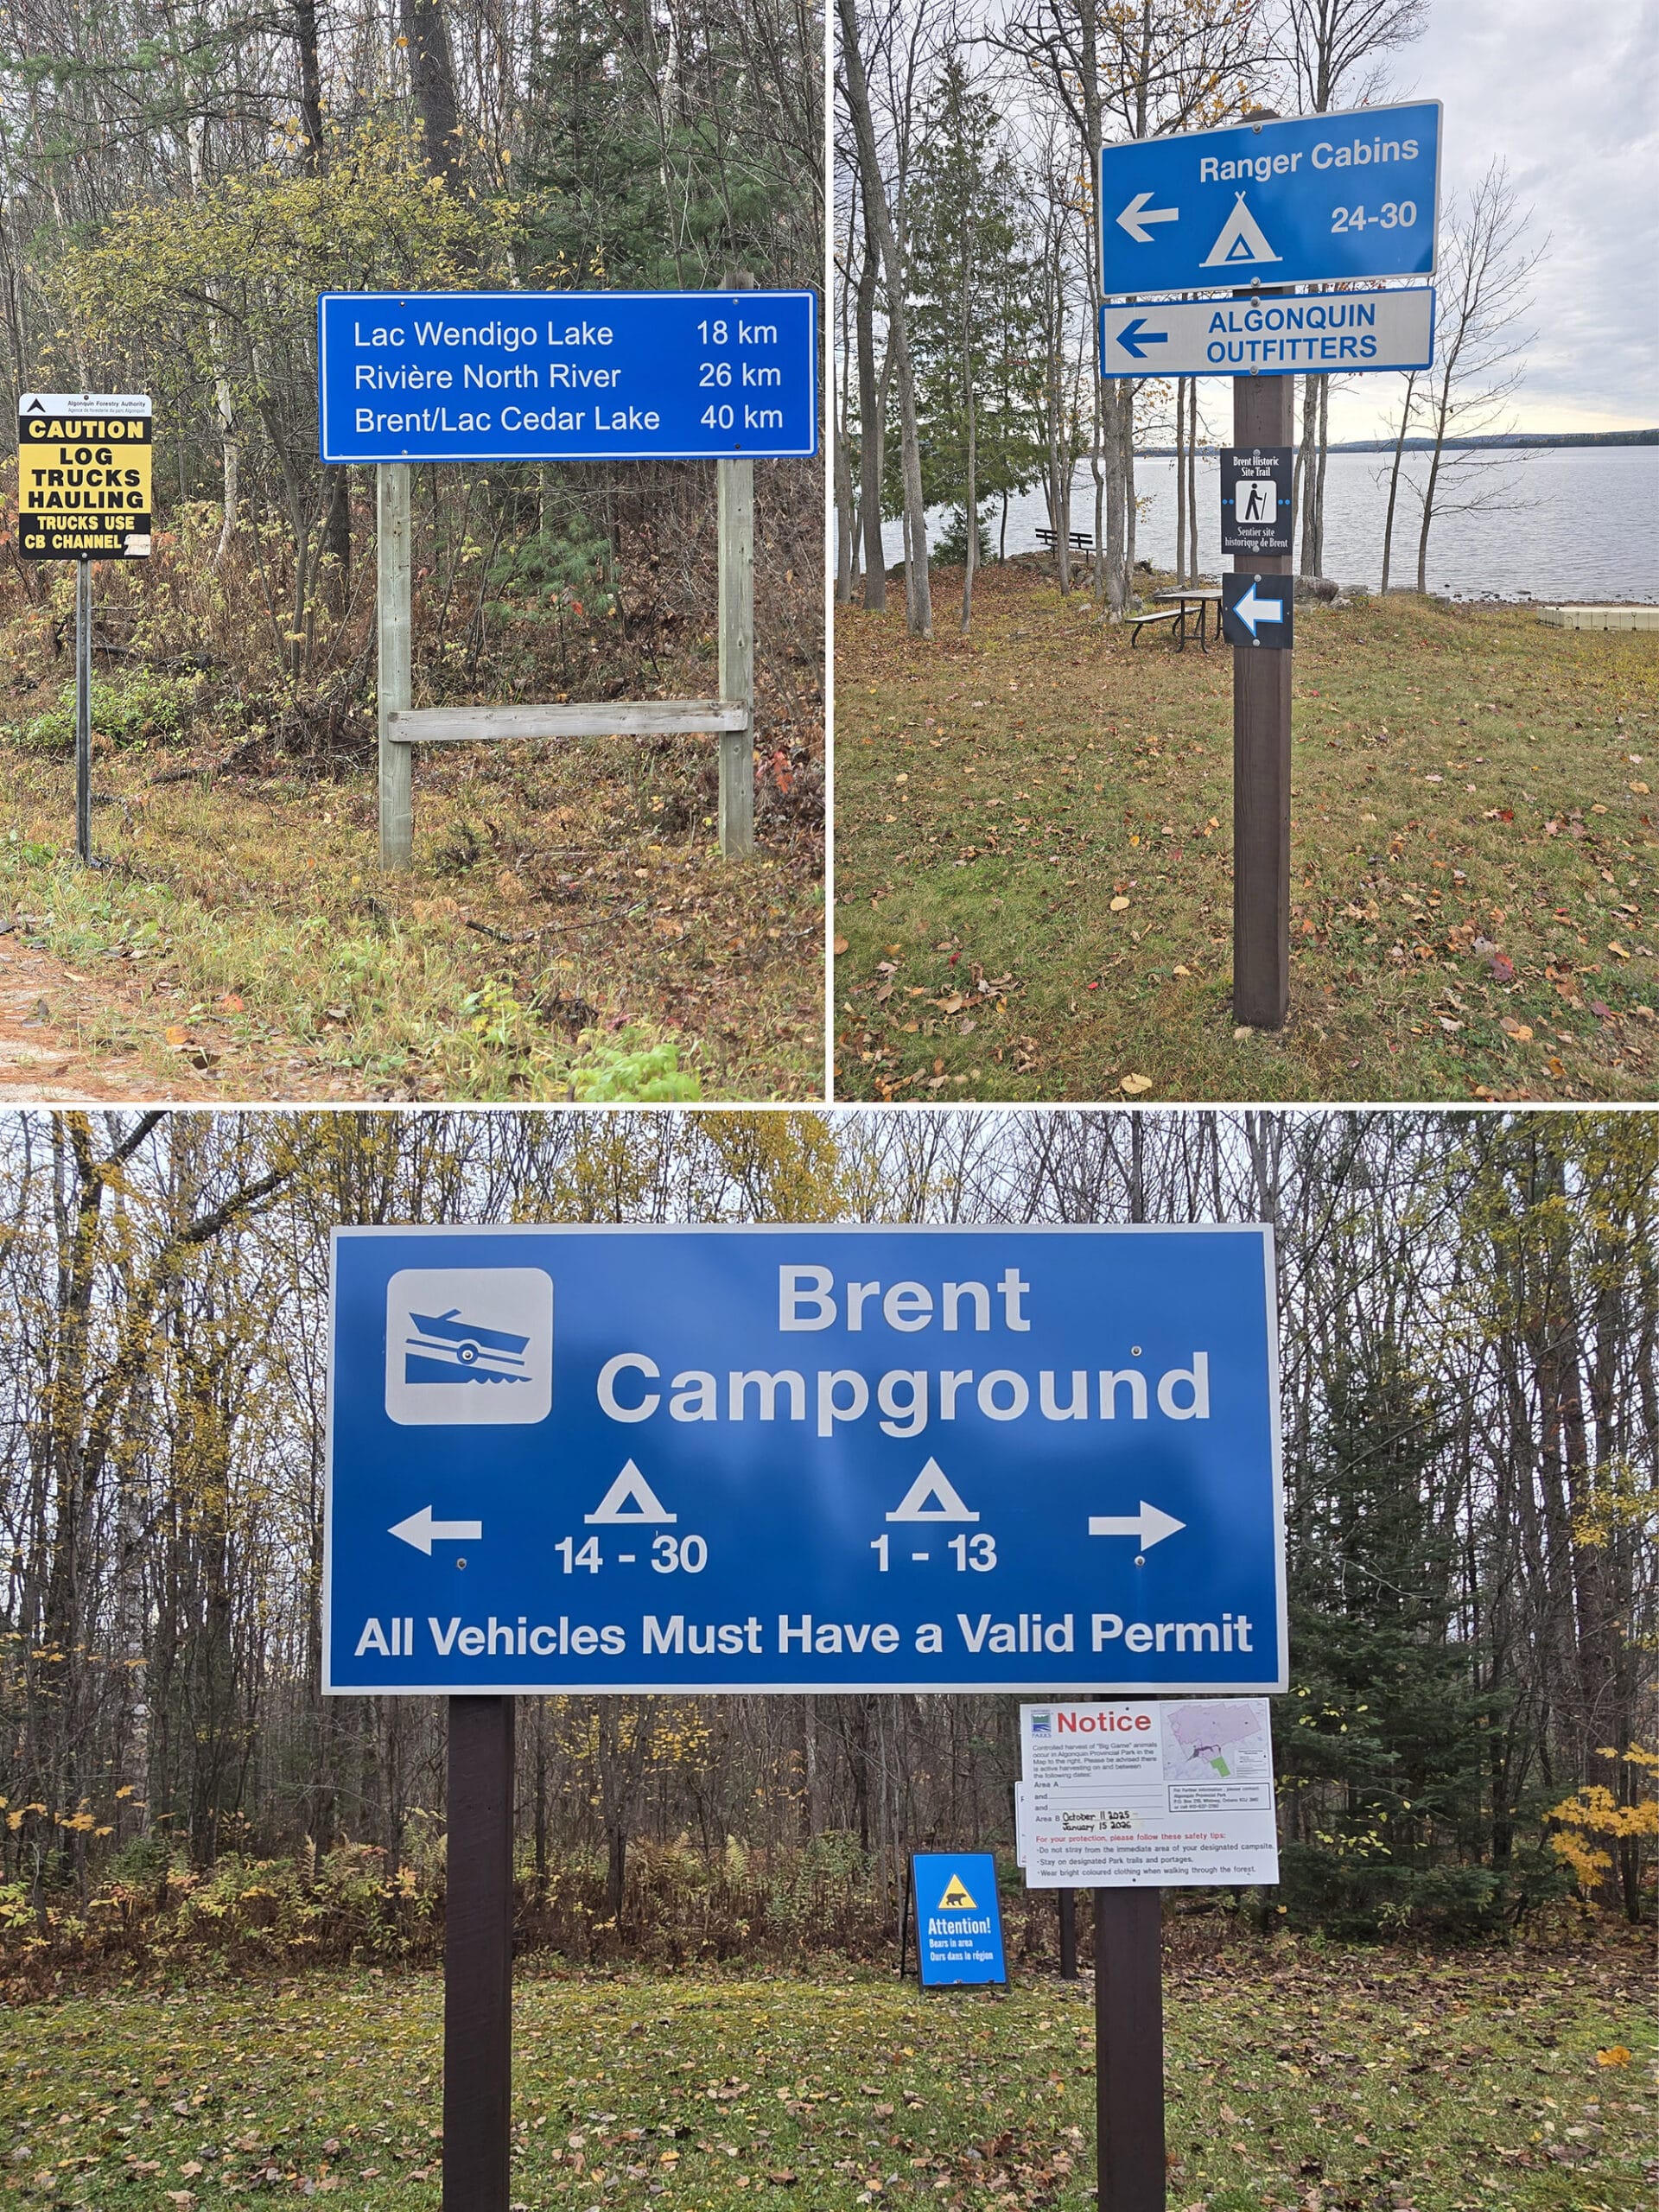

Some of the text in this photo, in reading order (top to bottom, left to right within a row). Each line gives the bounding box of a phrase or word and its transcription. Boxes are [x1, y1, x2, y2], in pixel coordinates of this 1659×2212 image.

[1199, 137, 1419, 183] Ranger Cabins
[1331, 200, 1417, 233] 24-30
[1208, 303, 1376, 334] ALGONQUIN
[354, 320, 778, 352] Lac Wendigo Lake 18 km
[1206, 334, 1376, 363] OUTFITTERS
[354, 362, 781, 390] Rivière North River 26 km
[355, 404, 783, 433] Brent/Lac Cedar Lake 40 km
[29, 420, 143, 439] CAUTION
[60, 448, 112, 465] LOG
[1233, 456, 1280, 466] Brent Historic
[32, 469, 140, 486] TRUCKS
[1241, 467, 1271, 477] Site Trail
[29, 491, 143, 508] HAULING
[37, 516, 135, 530] TRUCKS USE
[1237, 526, 1275, 537] Sentier site
[25, 534, 122, 549] CB CHANNEL
[1225, 537, 1288, 548] historique de Brent
[778, 1264, 1031, 1332] Brent
[596, 1351, 1211, 1438] Campground
[554, 1535, 603, 1573] 14
[652, 1535, 708, 1573] 30
[870, 1534, 889, 1572] 1
[948, 1533, 998, 1573] 13
[353, 1612, 1253, 1656] All Vehicles Must Have a Valid Permit
[1058, 1711, 1151, 1733] Notice
[1062, 1812, 1096, 1822] October
[1100, 1811, 1106, 1821] 11
[1108, 1810, 1130, 1820] 2025
[1062, 1821, 1132, 1832] January 15 2026
[1199, 1843, 1238, 1852] designated
[928, 1916, 991, 1935] Attention!
[929, 1938, 974, 1948] Bears in area
[930, 1951, 946, 1961] Ours
[947, 1951, 963, 1961] dans
